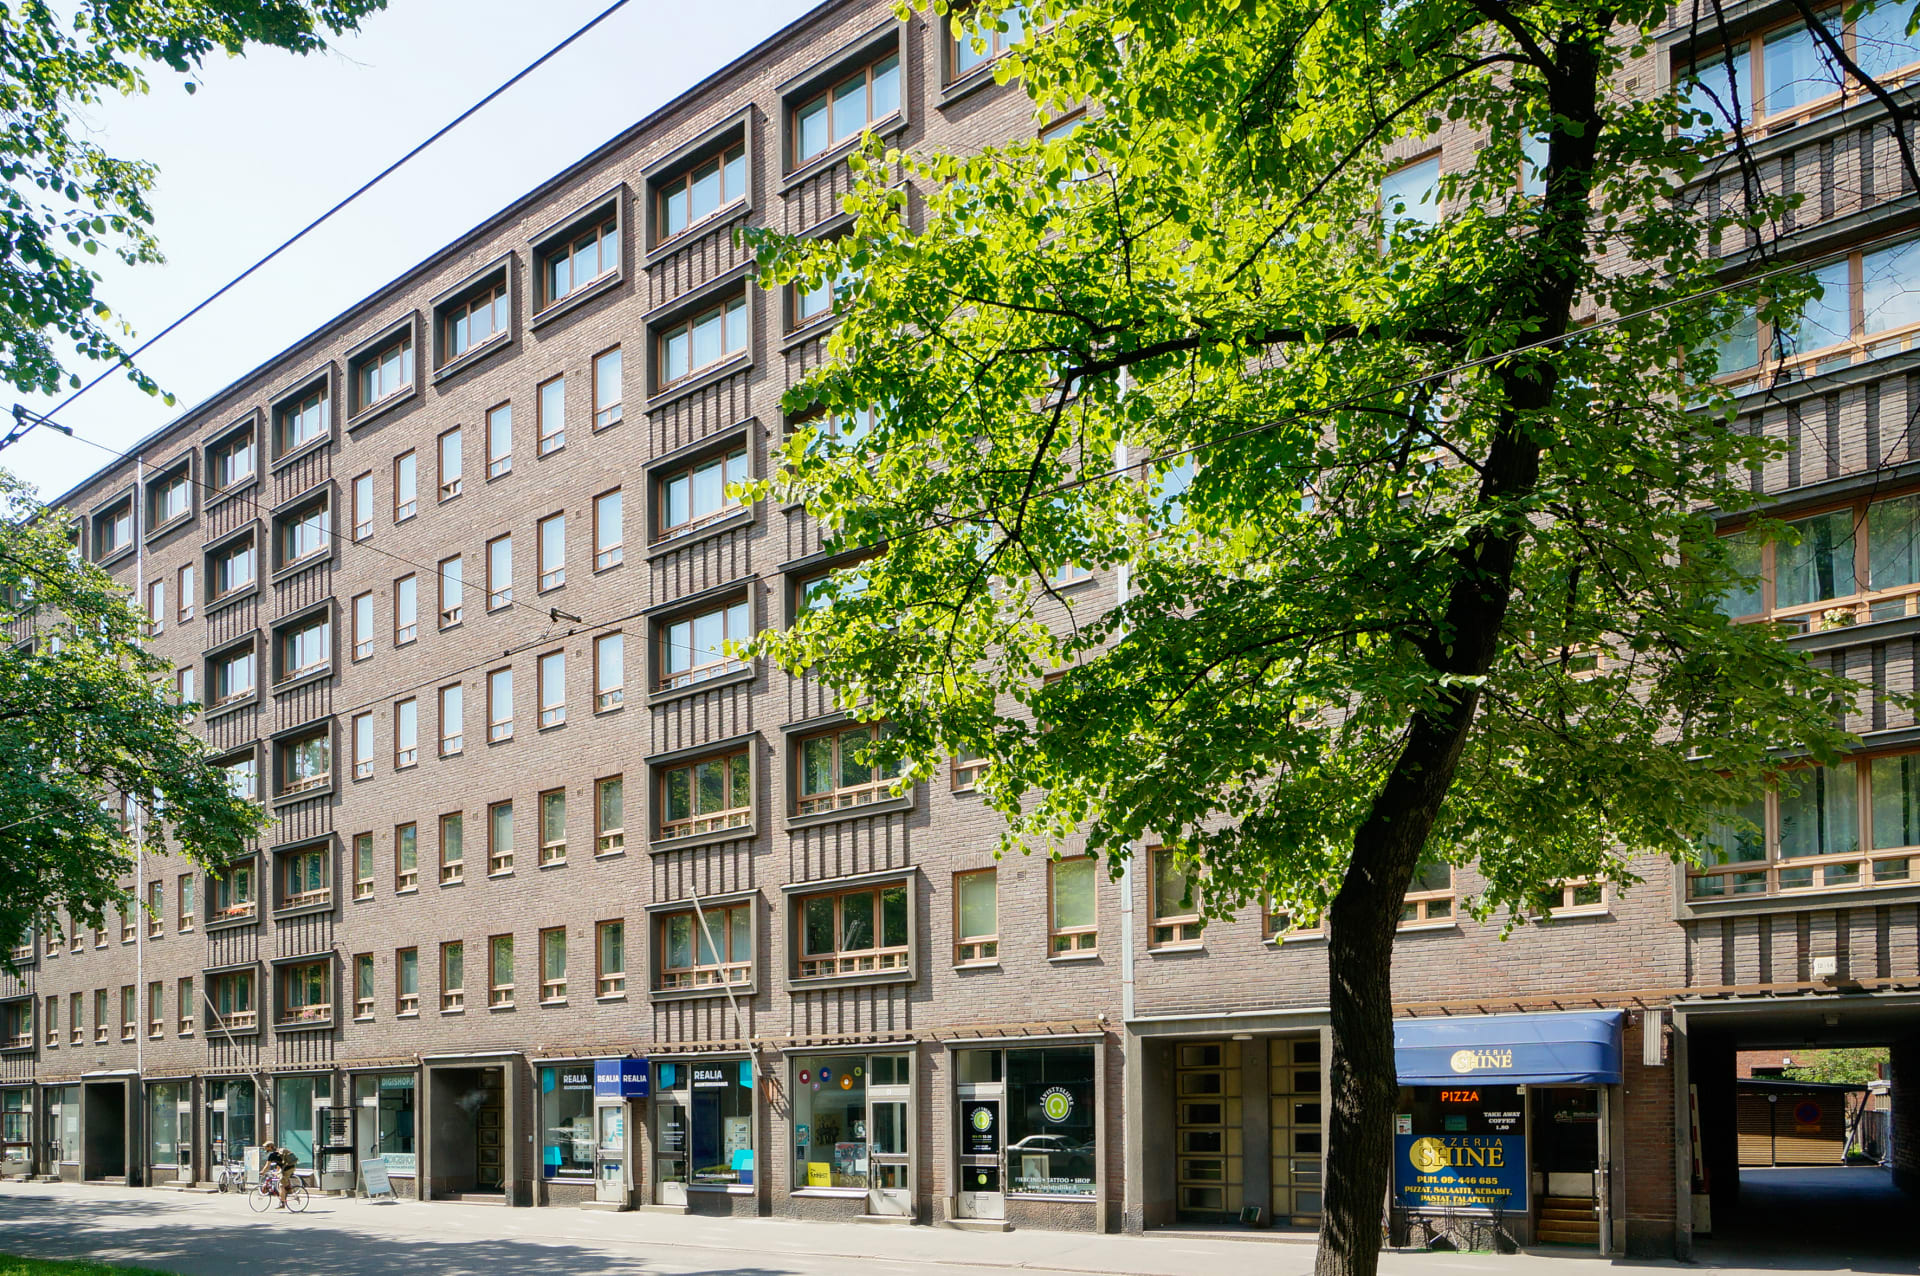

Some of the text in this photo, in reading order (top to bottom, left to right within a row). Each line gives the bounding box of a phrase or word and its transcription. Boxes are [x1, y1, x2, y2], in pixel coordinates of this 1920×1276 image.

[563, 1074, 588, 1084] REALIA
[597, 1074, 620, 1083] REALIA
[623, 1074, 648, 1082] REALIA
[694, 1070, 723, 1080] REALIA
[1441, 1091, 1480, 1102] PIZZA
[1419, 1137, 1503, 1147] PIZZERIA
[1418, 1147, 1506, 1168] SHINE
[1416, 1176, 1440, 1184] PUH.
[1457, 1176, 1477, 1184] 446
[1478, 1177, 1499, 1185] 685
[1404, 1186, 1513, 1196] PIZZAT, SALAATIT, KEBABIT,
